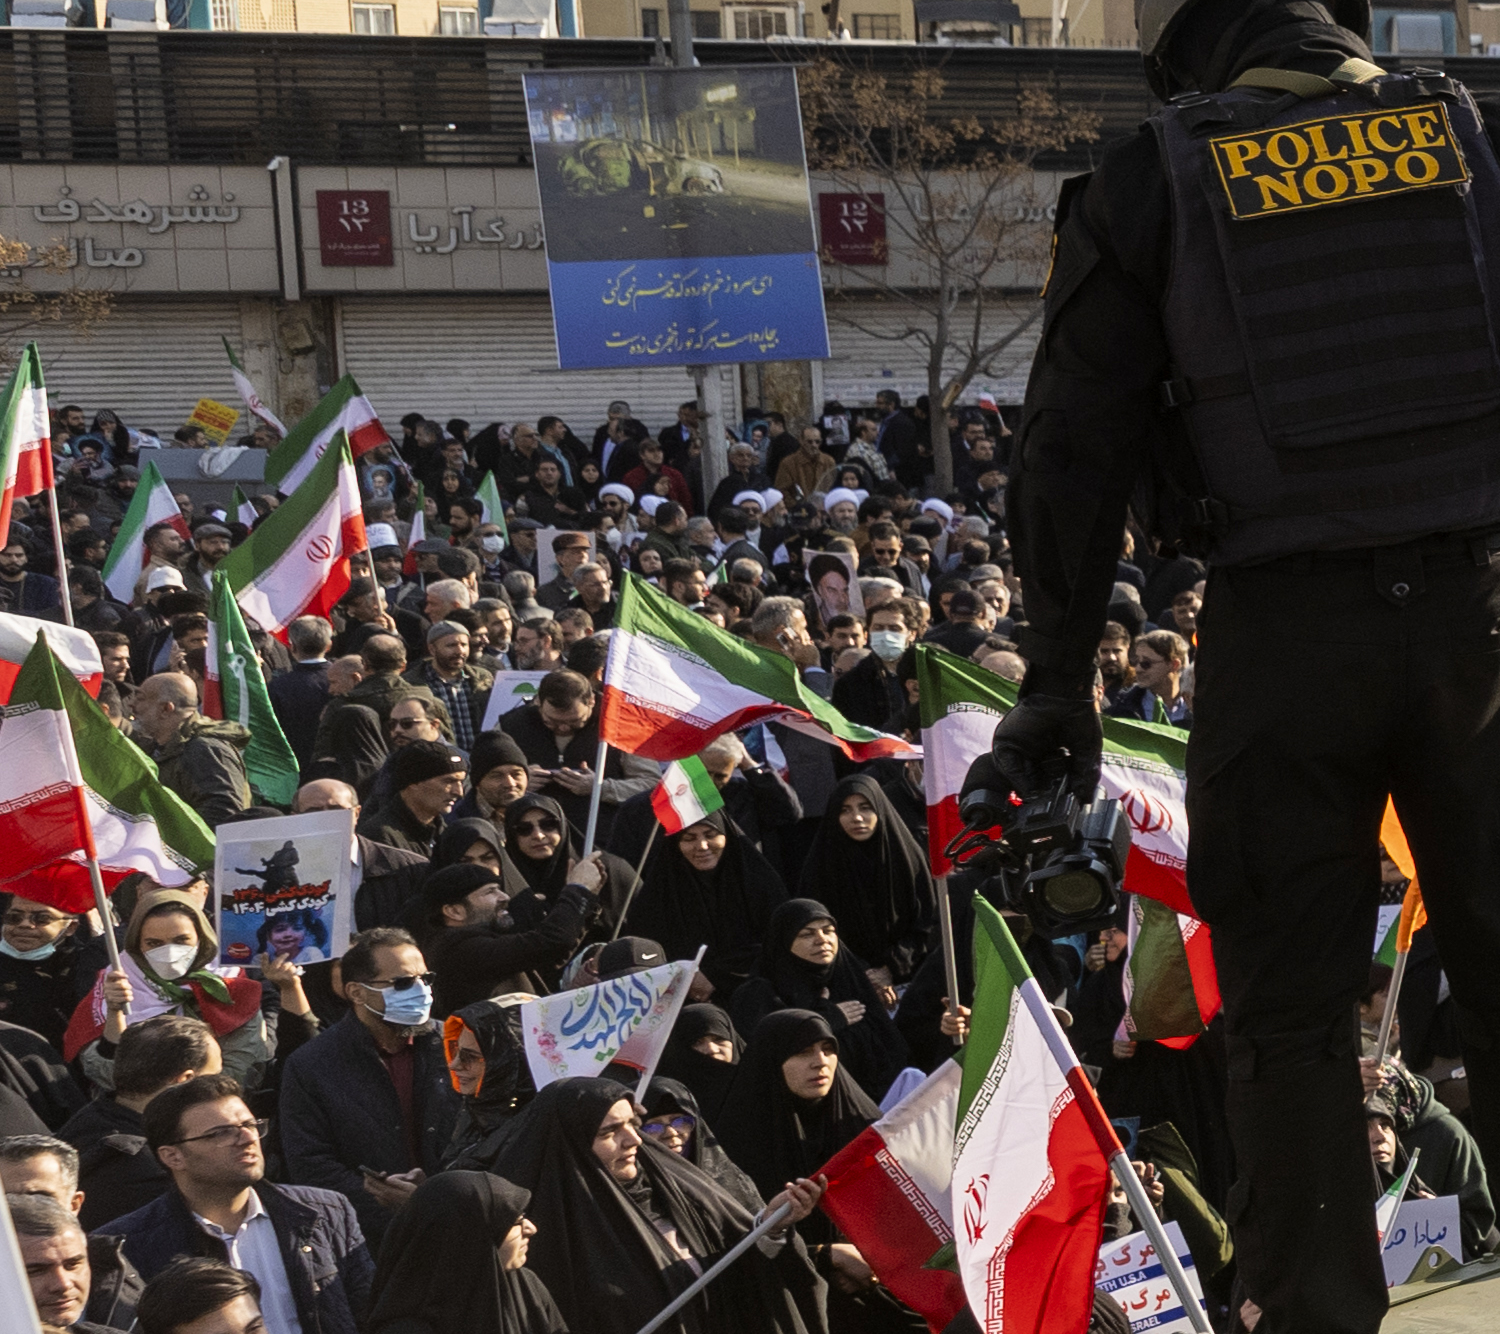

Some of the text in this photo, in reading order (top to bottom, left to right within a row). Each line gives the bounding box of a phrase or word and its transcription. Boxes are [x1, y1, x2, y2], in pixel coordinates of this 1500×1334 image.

[1218, 110, 1446, 179] POLICE
[1252, 151, 1440, 209] NOPO
[33, 184, 241, 235] نشر هدف
[339, 199, 370, 216] 13
[840, 201, 868, 217] 12
[409, 206, 544, 254] زرگ آریا
[232, 894, 329, 917] کودک کشی ۱۴۰۴
[1112, 1242, 1157, 1267] مرگ
[1118, 1270, 1148, 1287] U.S.A
[1130, 1286, 1171, 1312] مرگ
[1130, 1315, 1162, 1332] SRAEL
